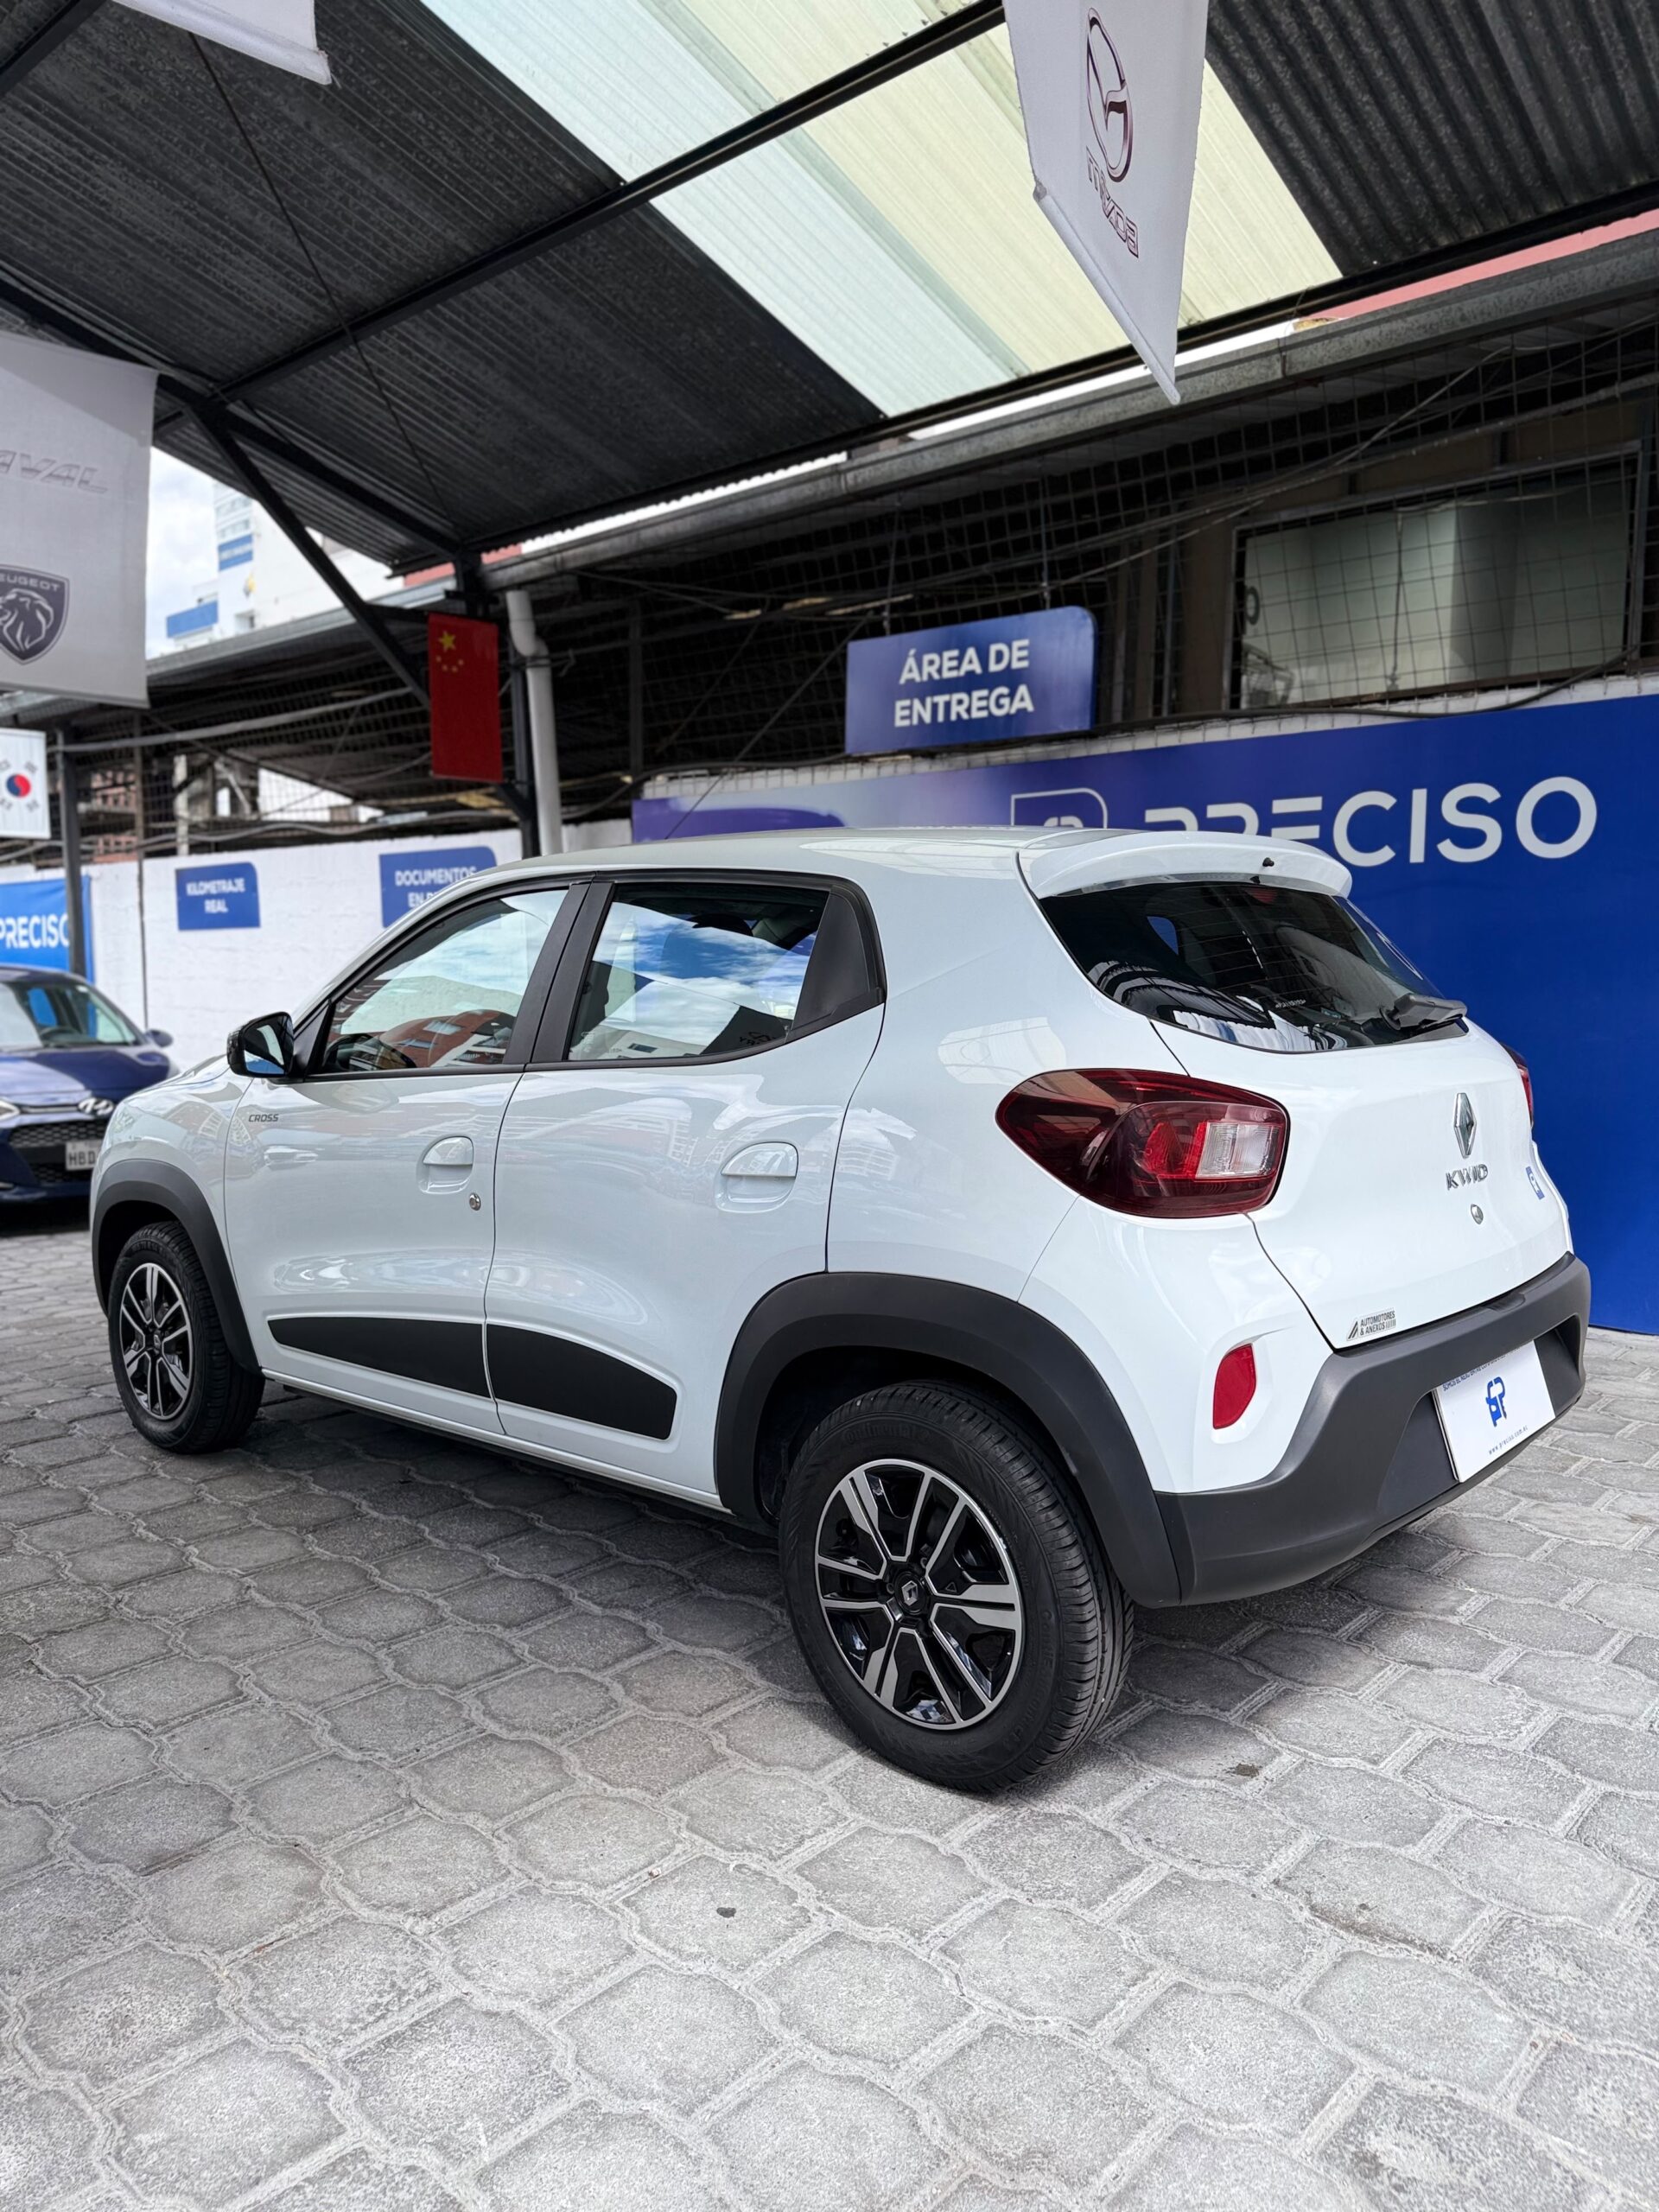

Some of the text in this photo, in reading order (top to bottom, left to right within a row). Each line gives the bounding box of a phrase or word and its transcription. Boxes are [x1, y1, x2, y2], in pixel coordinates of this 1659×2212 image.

[899, 639, 1030, 685] ÁREA DE
[894, 683, 1034, 728] ENTREGA
[186, 877, 245, 896] KILOMETRAJE
[204, 899, 229, 913] REAL
[248, 1113, 279, 1122] CROSS
[1446, 1163, 1489, 1191] KWID
[1360, 1310, 1395, 1328] AUTOMOTORES
[1365, 1321, 1386, 1334] ANEXOS
